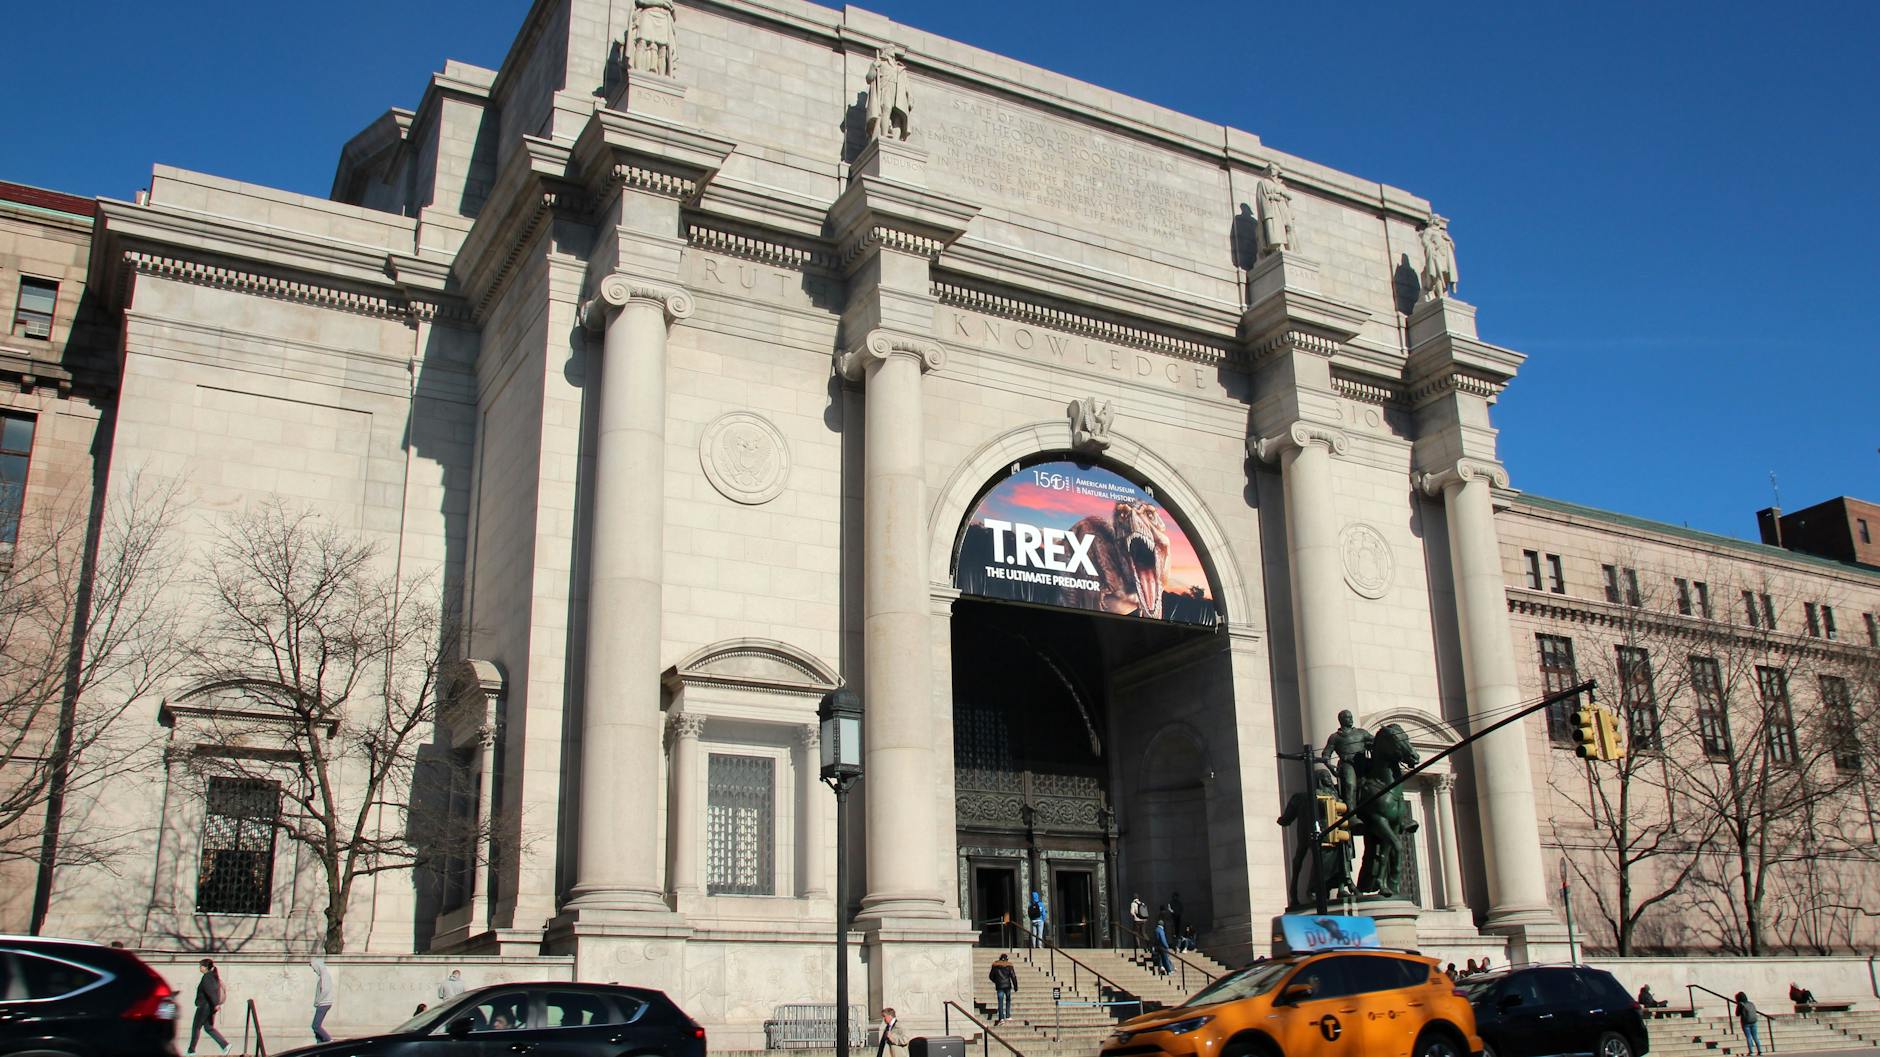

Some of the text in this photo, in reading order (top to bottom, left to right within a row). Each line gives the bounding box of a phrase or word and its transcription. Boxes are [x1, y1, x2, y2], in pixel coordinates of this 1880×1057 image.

[911, 126, 922, 137] IN
[927, 130, 969, 148] ENERGY
[975, 144, 998, 157] AND
[1001, 152, 1058, 175] FORTITUDE
[1064, 168, 1074, 178] IN
[1080, 173, 1098, 187] THE
[1102, 178, 1129, 194] FAITH
[1134, 189, 1146, 199] OF
[1150, 194, 1170, 207] OUR
[938, 122, 1193, 203] A GREAT LEADER OF THE YOUTH OF AMERICA
[952, 99, 1175, 172] STATE OF NEW YORK MEMORIAL TO
[983, 120, 1150, 179] THEODORE ROOSEVELT
[937, 155, 949, 167] IN
[955, 162, 977, 175] THE
[983, 168, 1014, 184] LOVE
[1018, 178, 1041, 191] AND
[1046, 186, 1130, 217] CONSERVATION
[1135, 211, 1147, 222] OF
[947, 147, 960, 159] IN
[965, 152, 1013, 173] DEFENSE
[1018, 167, 1031, 177] OF
[1037, 172, 1057, 185] THE
[1063, 179, 1103, 198] RIGHTS
[1107, 191, 1120, 202] OF
[1126, 196, 1143, 209] THE
[960, 175, 1176, 240] AND OF THE BEST IN LIFE AND IN MAN
[953, 313, 1207, 389] KNOWLEDGE
[1033, 470, 1065, 490] 150
[1076, 478, 1135, 494] AMERICAN MUSEUM
[1081, 487, 1109, 498] NATURAL
[1110, 492, 1135, 502] HISTORY
[984, 518, 1099, 577] T.REX
[985, 566, 1100, 591] THE ULTIMATE PREDATOR
